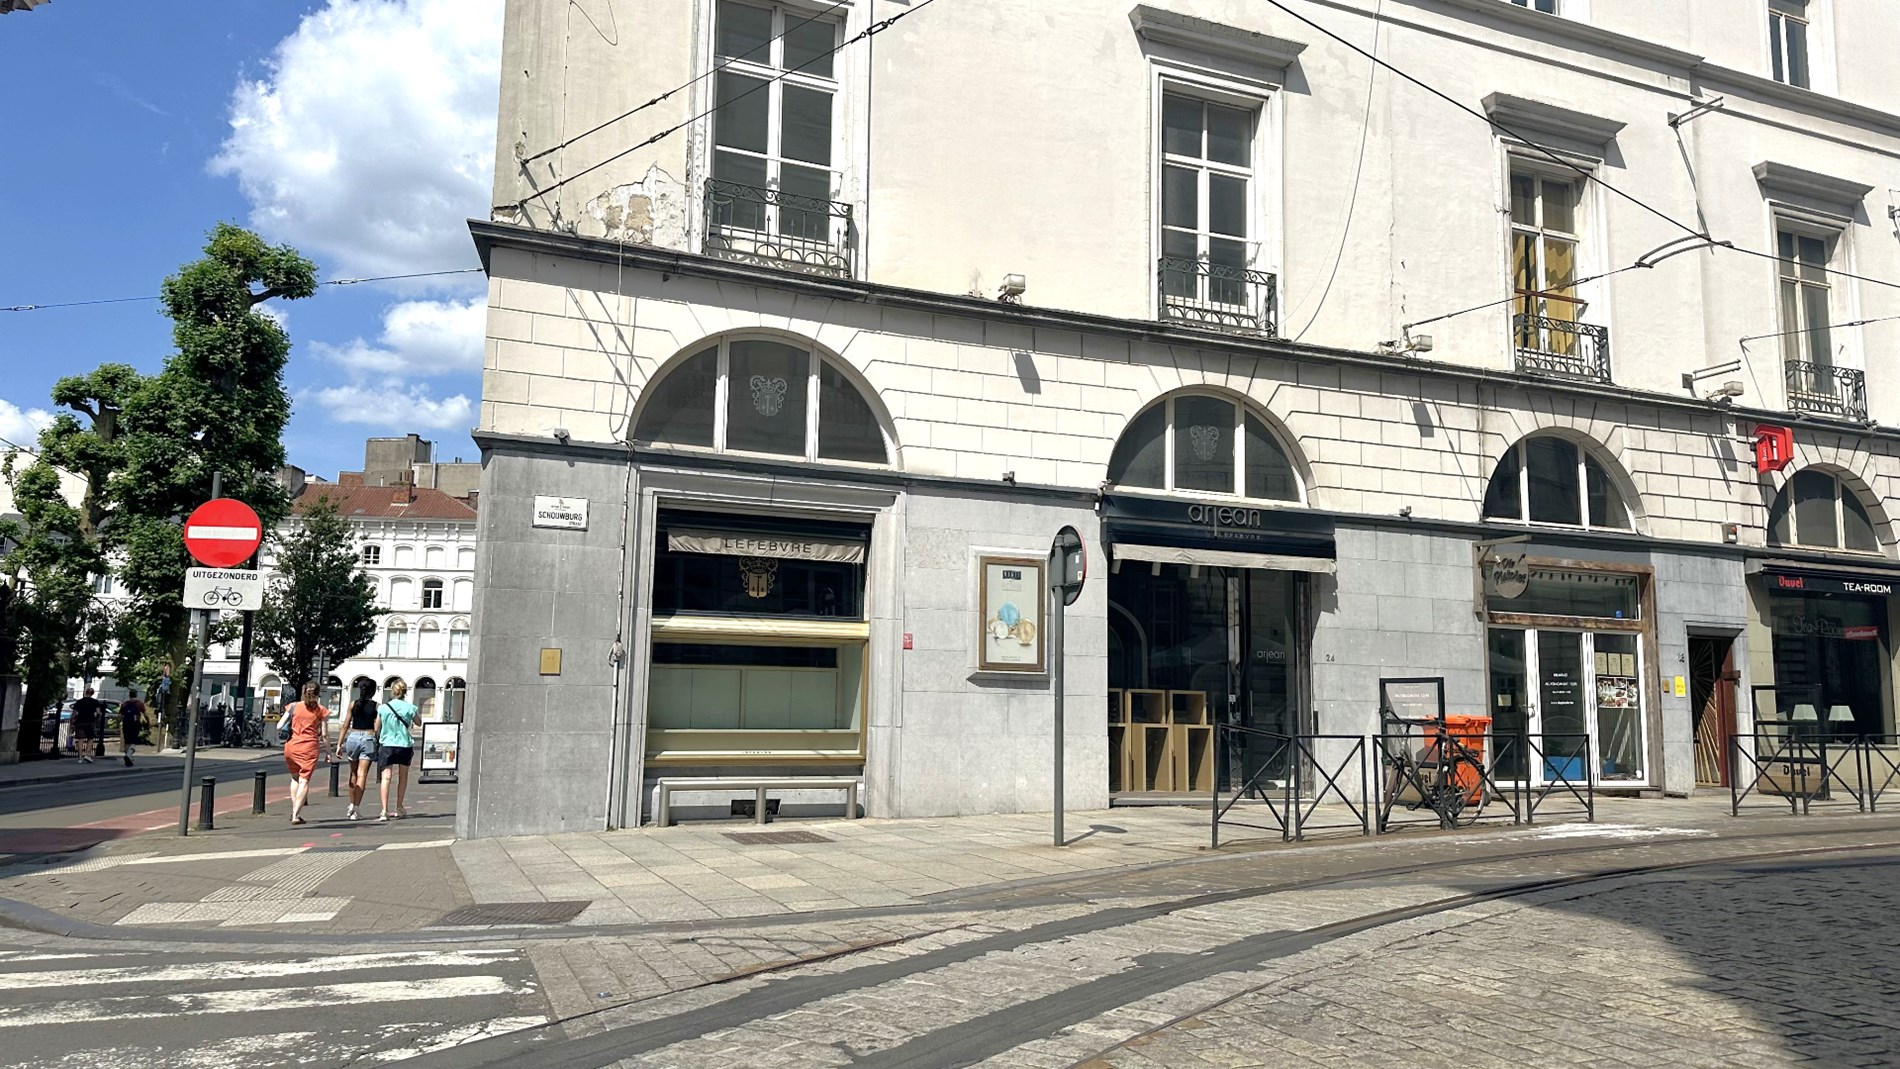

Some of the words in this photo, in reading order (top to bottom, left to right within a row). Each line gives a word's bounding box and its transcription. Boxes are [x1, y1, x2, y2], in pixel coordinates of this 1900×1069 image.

[538, 510, 583, 522] SCHOUWBURG
[1188, 504, 1260, 537] arjean
[724, 538, 812, 553] LEFEBVRE
[192, 570, 259, 581] UITGEZONDERD
[1778, 575, 1804, 589] Duvel
[1842, 582, 1892, 594] TEA-ROOM
[1325, 653, 1335, 662] 24
[1783, 764, 1811, 777] Dvl
